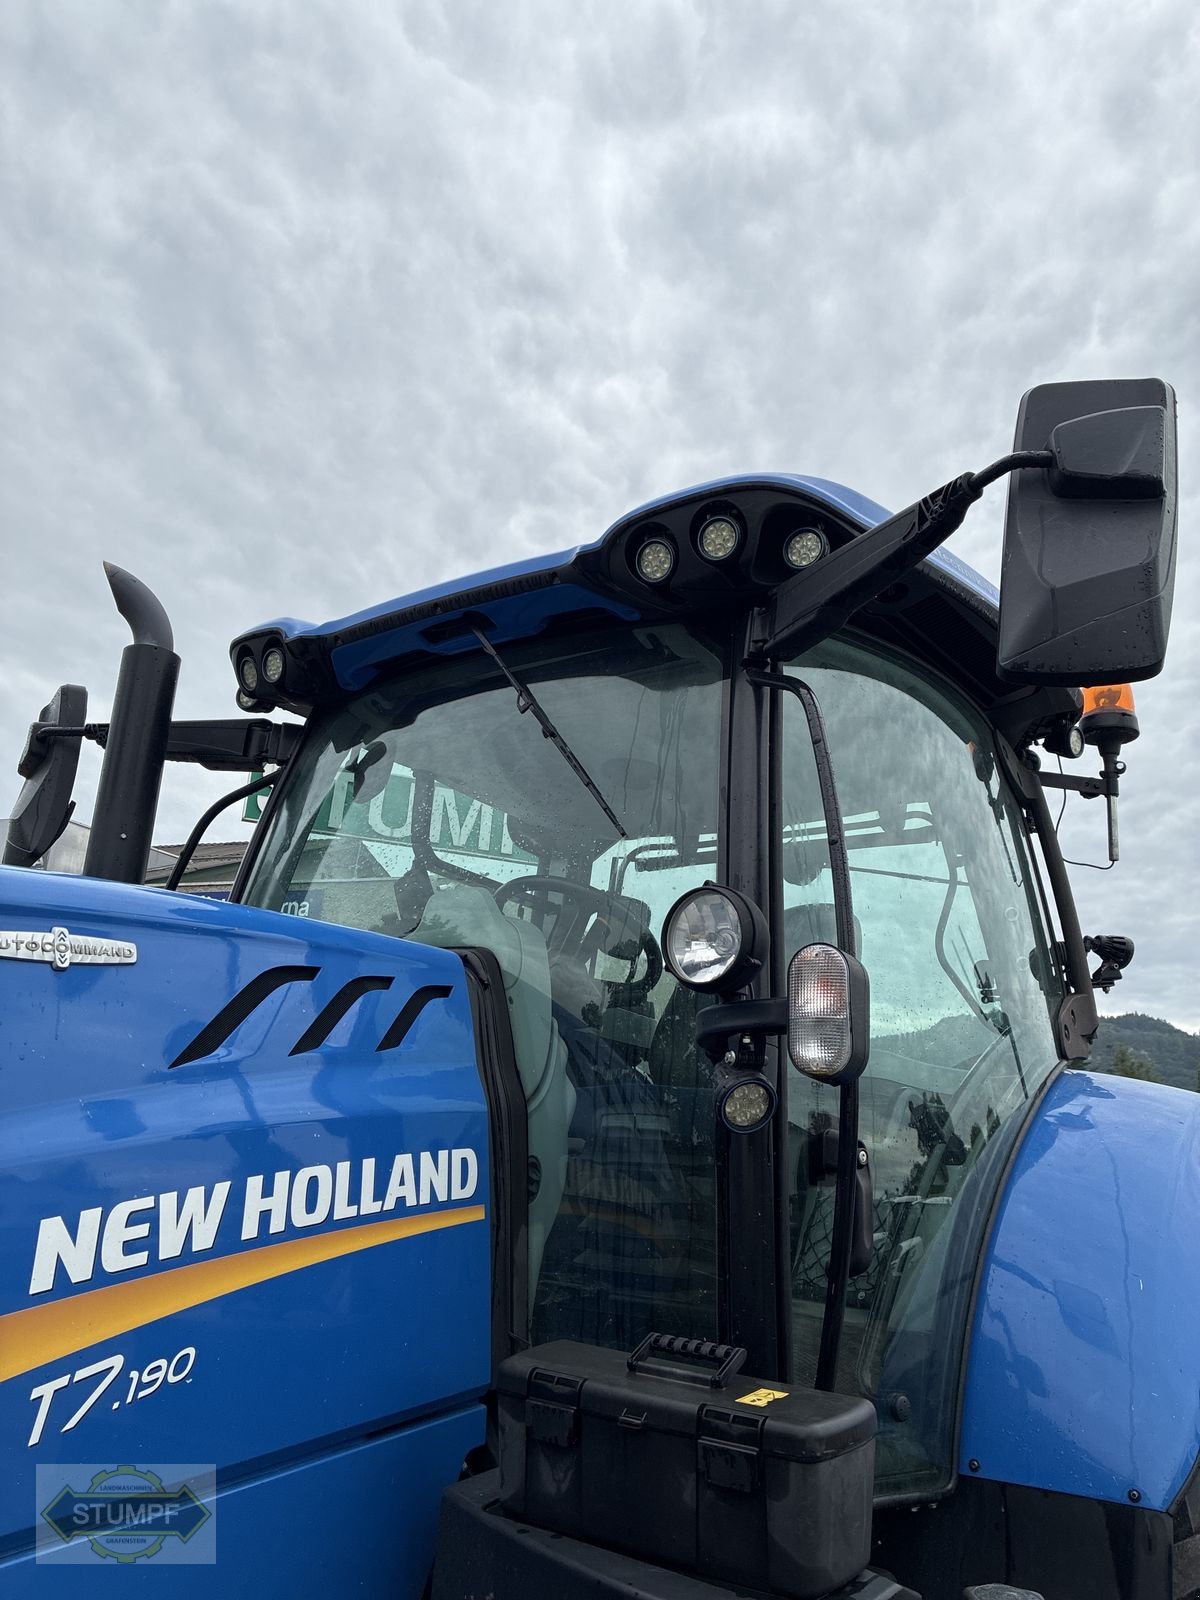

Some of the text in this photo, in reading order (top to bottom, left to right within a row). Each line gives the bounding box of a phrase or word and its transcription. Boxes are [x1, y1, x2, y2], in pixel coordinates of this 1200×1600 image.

[0, 939, 135, 959] UTOCOMMAND
[29, 1148, 478, 1295] NEW HOLLAND
[27, 1346, 196, 1447] T7.190
